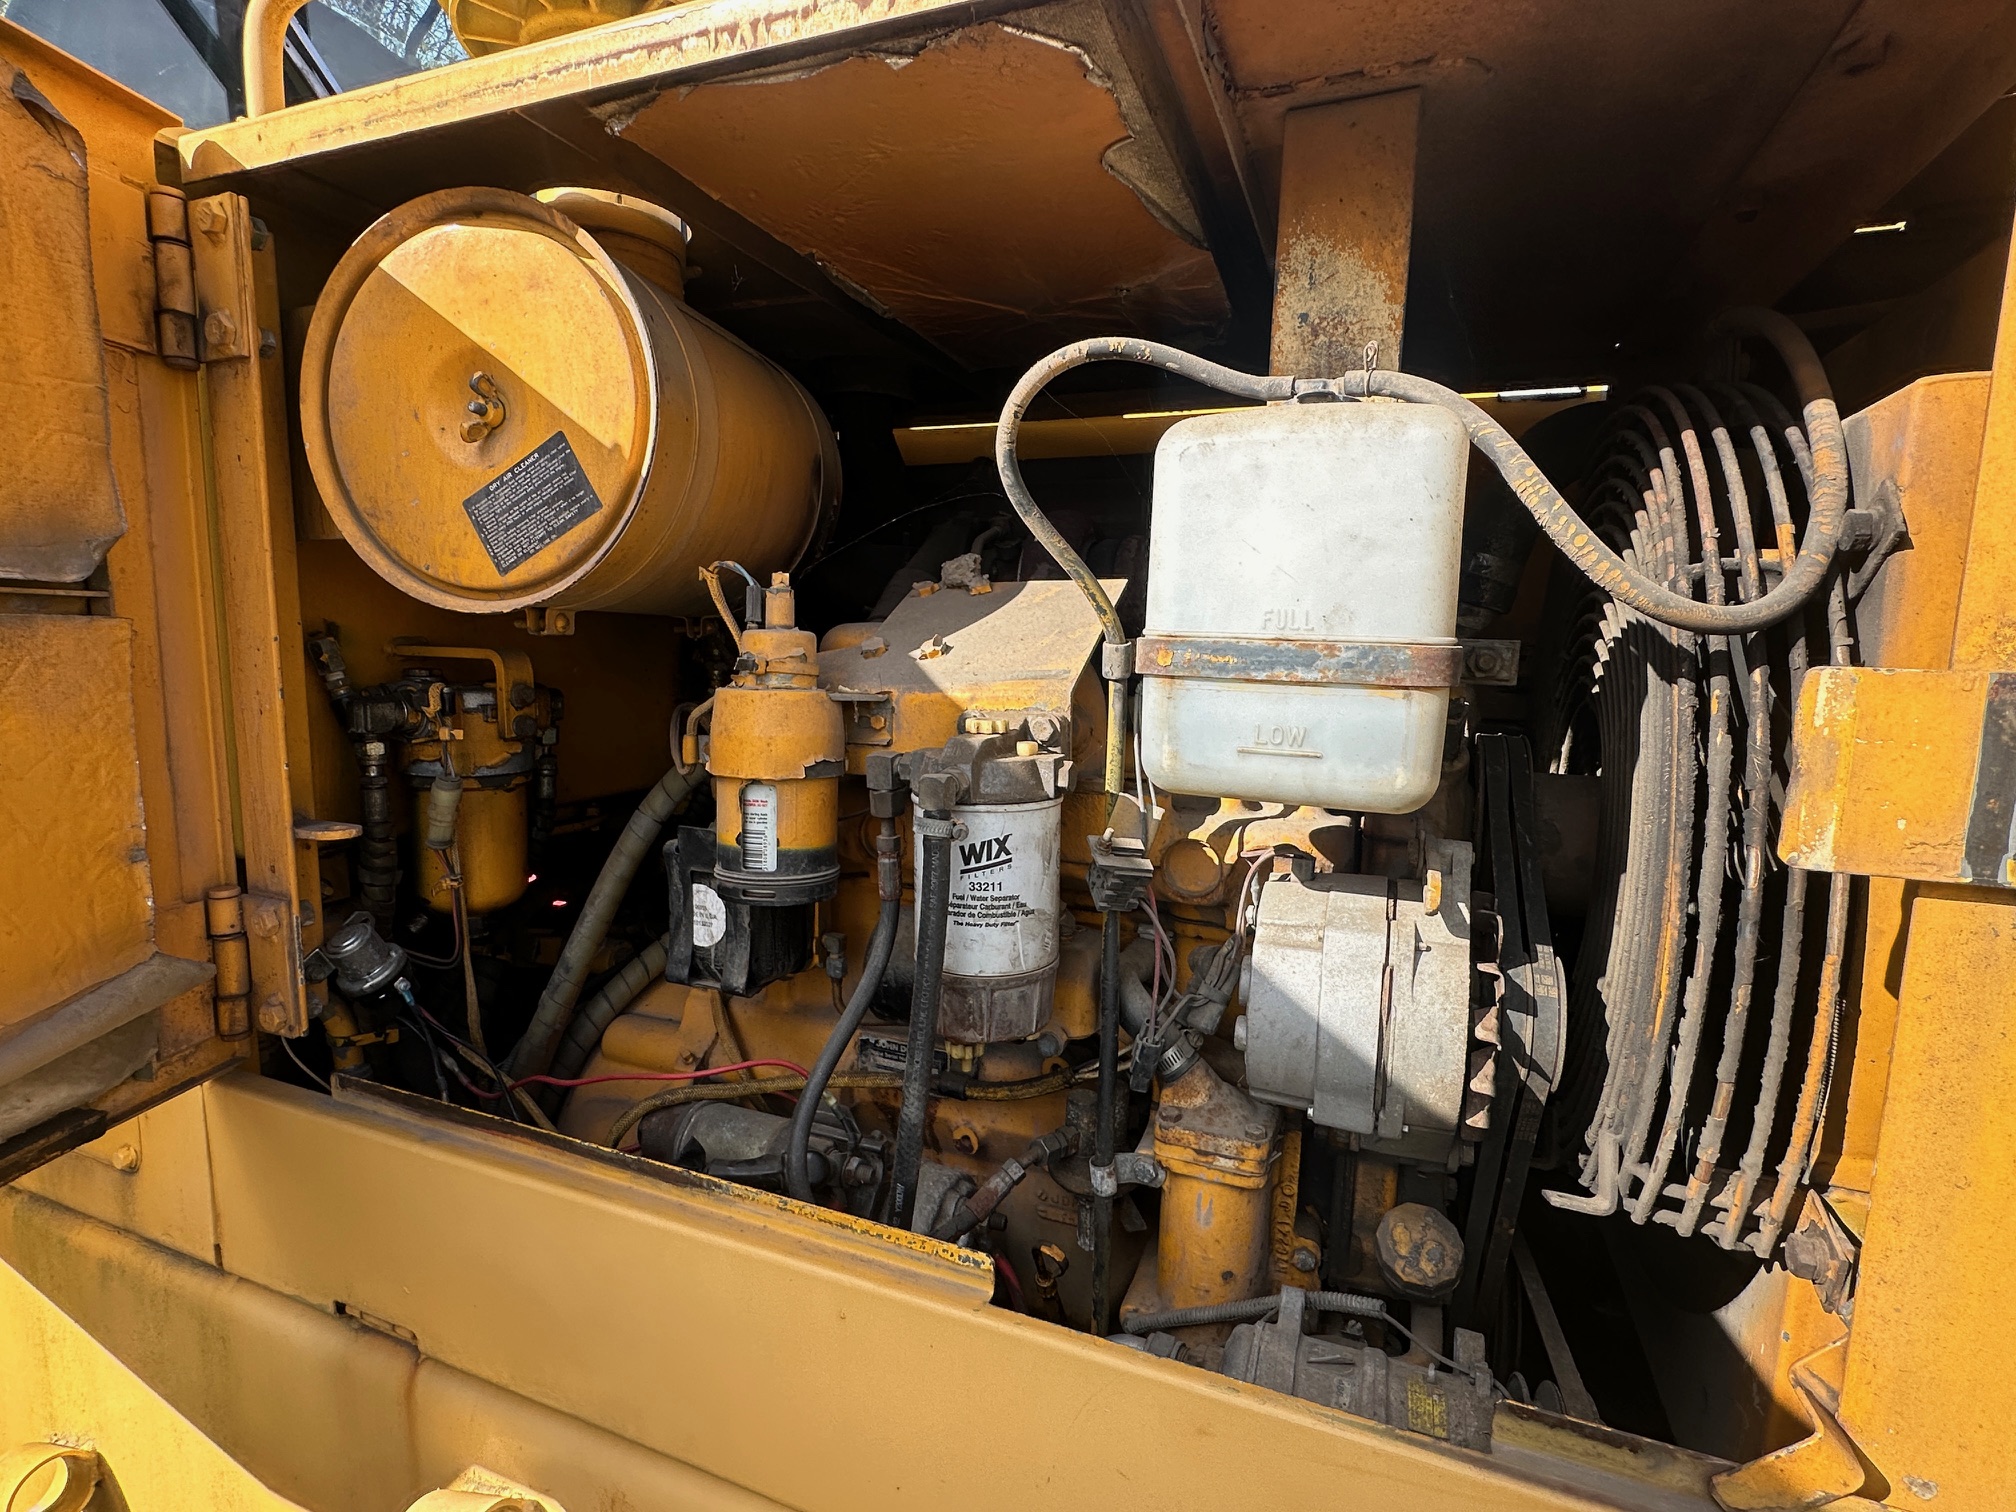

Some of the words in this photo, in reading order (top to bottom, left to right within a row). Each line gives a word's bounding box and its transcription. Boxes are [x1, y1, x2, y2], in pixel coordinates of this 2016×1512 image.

[489, 481, 500, 491] DRY
[503, 472, 513, 482] AIR
[514, 453, 539, 473] CLEANER
[1262, 608, 1315, 631] FULL
[1254, 723, 1307, 747] LOW
[959, 833, 1013, 867] WIX
[960, 864, 1013, 880] FILTERS
[968, 881, 1003, 892] 33211
[952, 893, 966, 901] Fuel
[970, 894, 989, 902] Water
[990, 894, 1020, 903] Separator
[948, 901, 978, 910] éparateur
[979, 902, 1012, 911] Carburant
[1016, 901, 1027, 909] Eau
[977, 911, 1017, 919] Combustible
[1021, 909, 1035, 918] Agua
[965, 921, 983, 929] Heavy
[984, 921, 999, 929] Duty
[875, 1039, 899, 1051] JOHN
